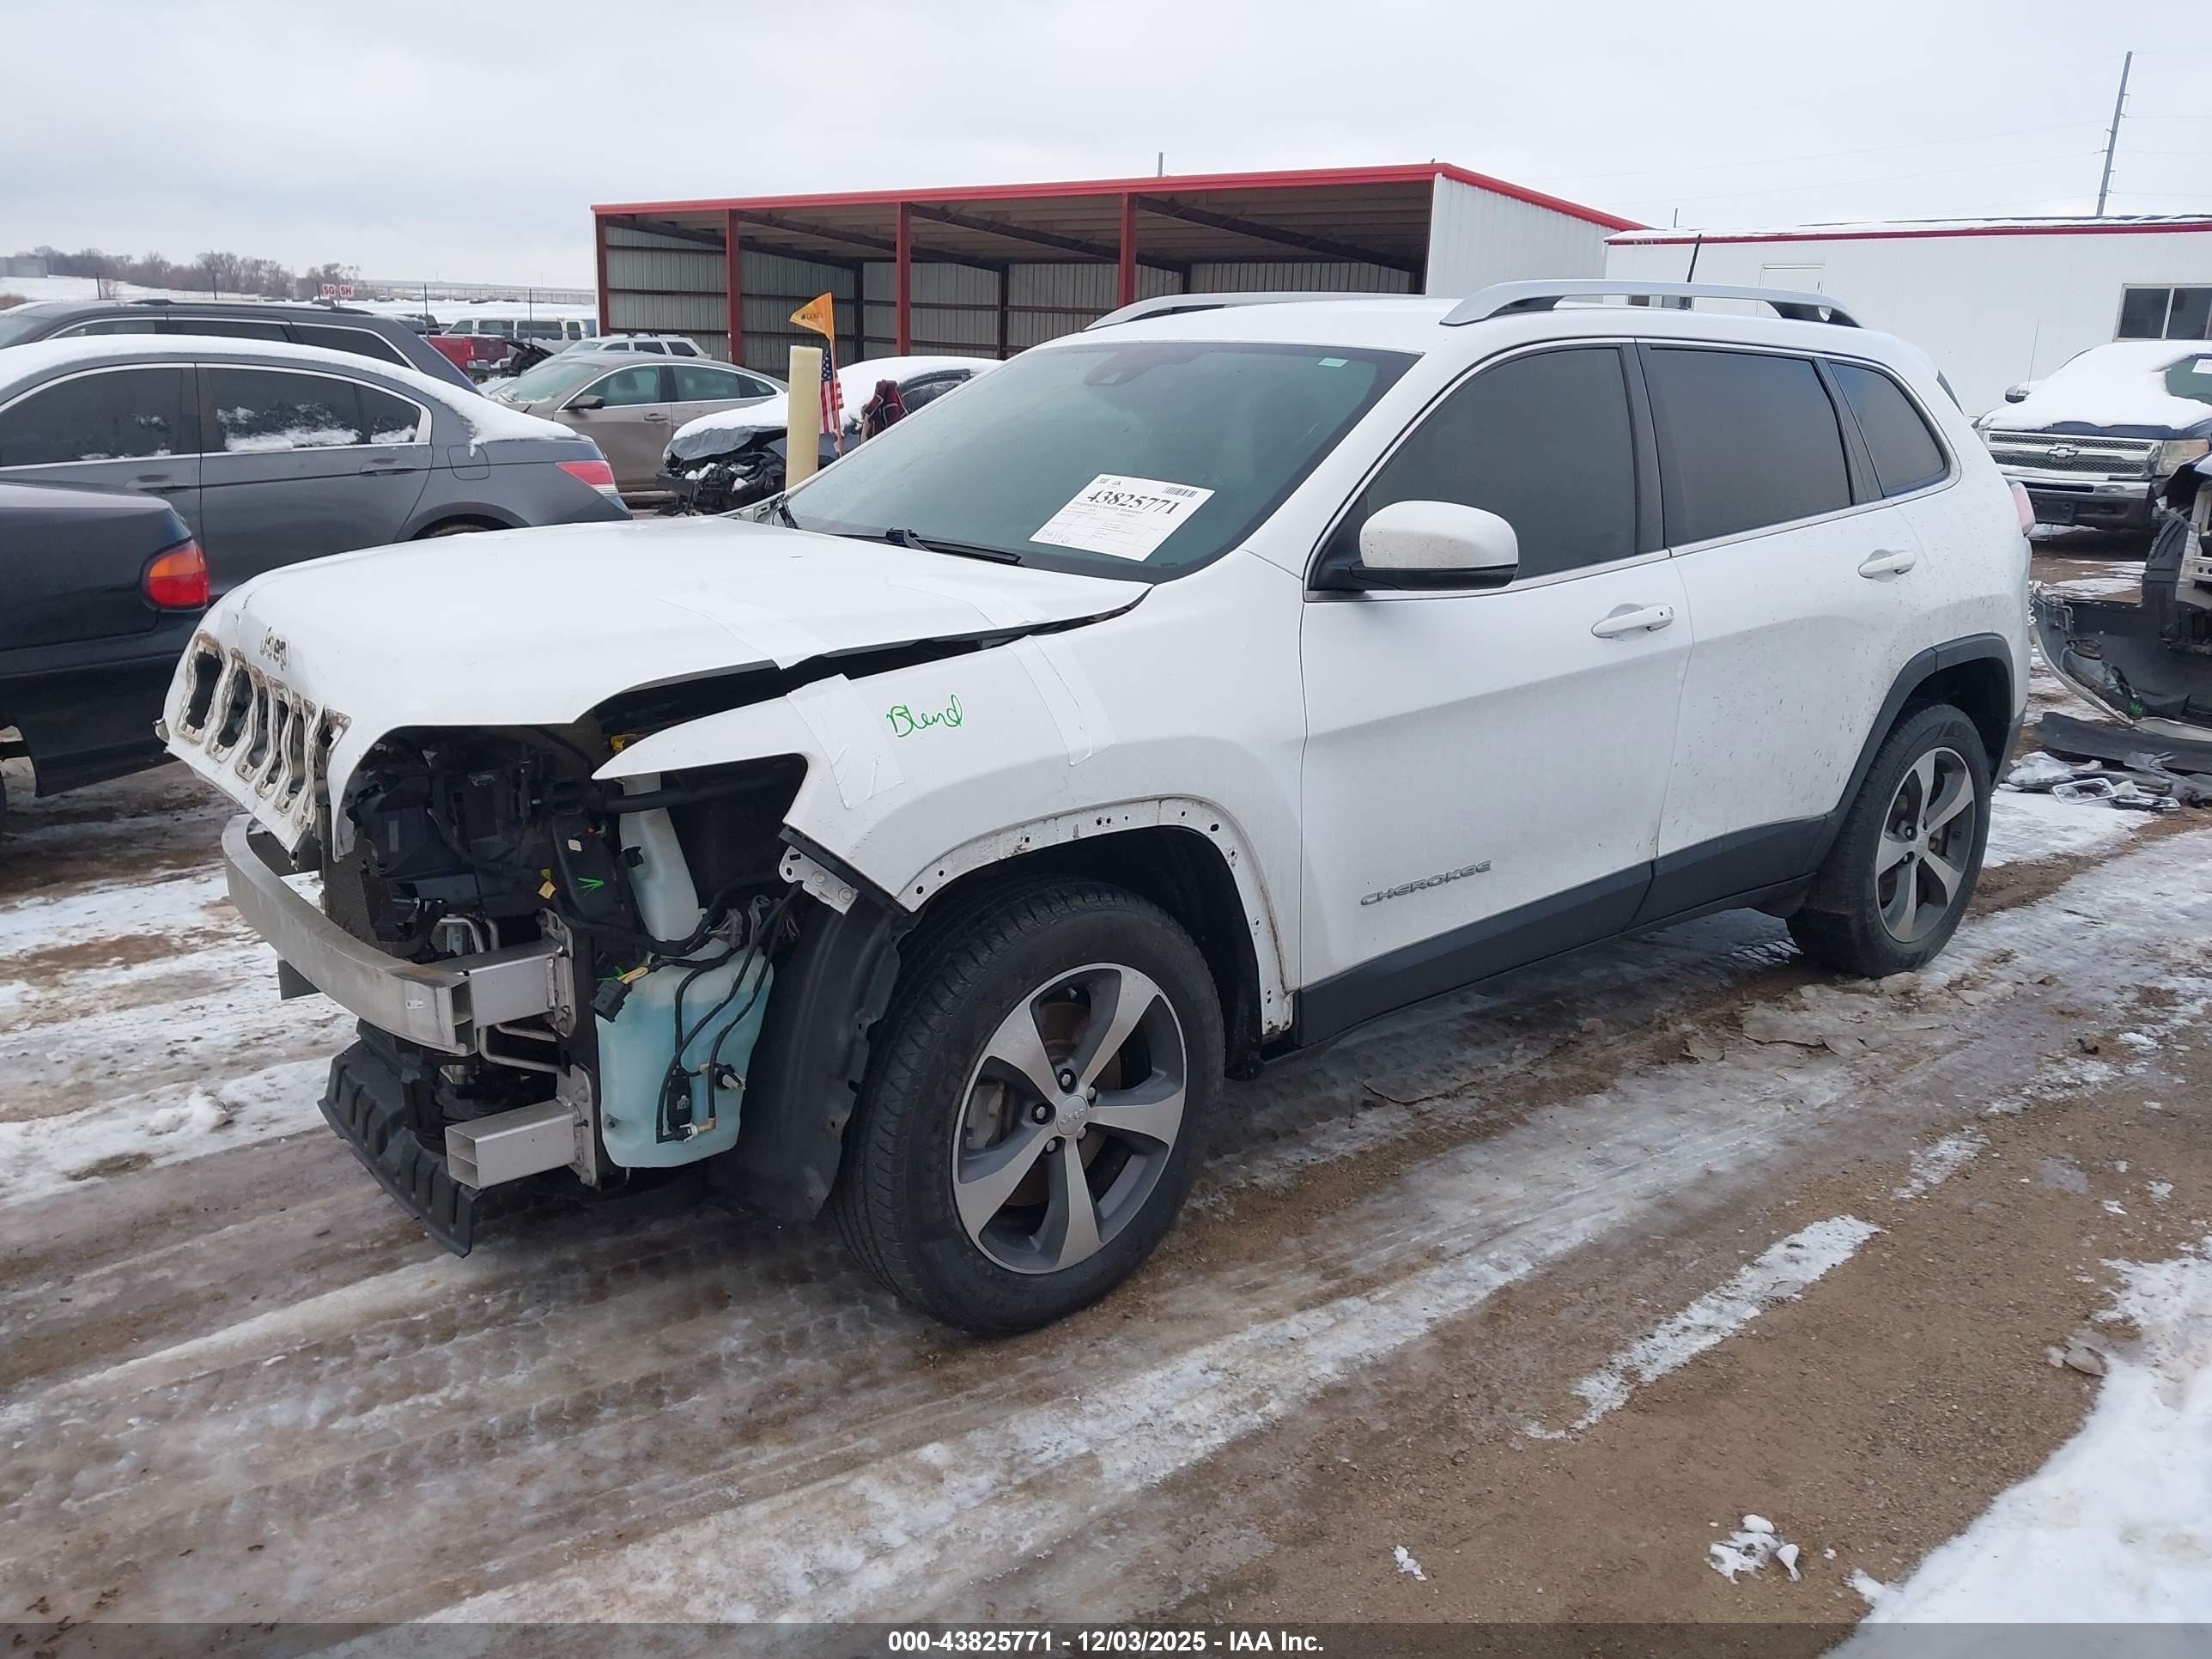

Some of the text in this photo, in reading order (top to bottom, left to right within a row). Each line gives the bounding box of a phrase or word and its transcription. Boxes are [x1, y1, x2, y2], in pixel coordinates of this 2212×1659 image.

[1086, 489, 1182, 515] 43825771
[886, 693, 963, 738] Blend
[1360, 860, 1492, 906] CHEROKEE
